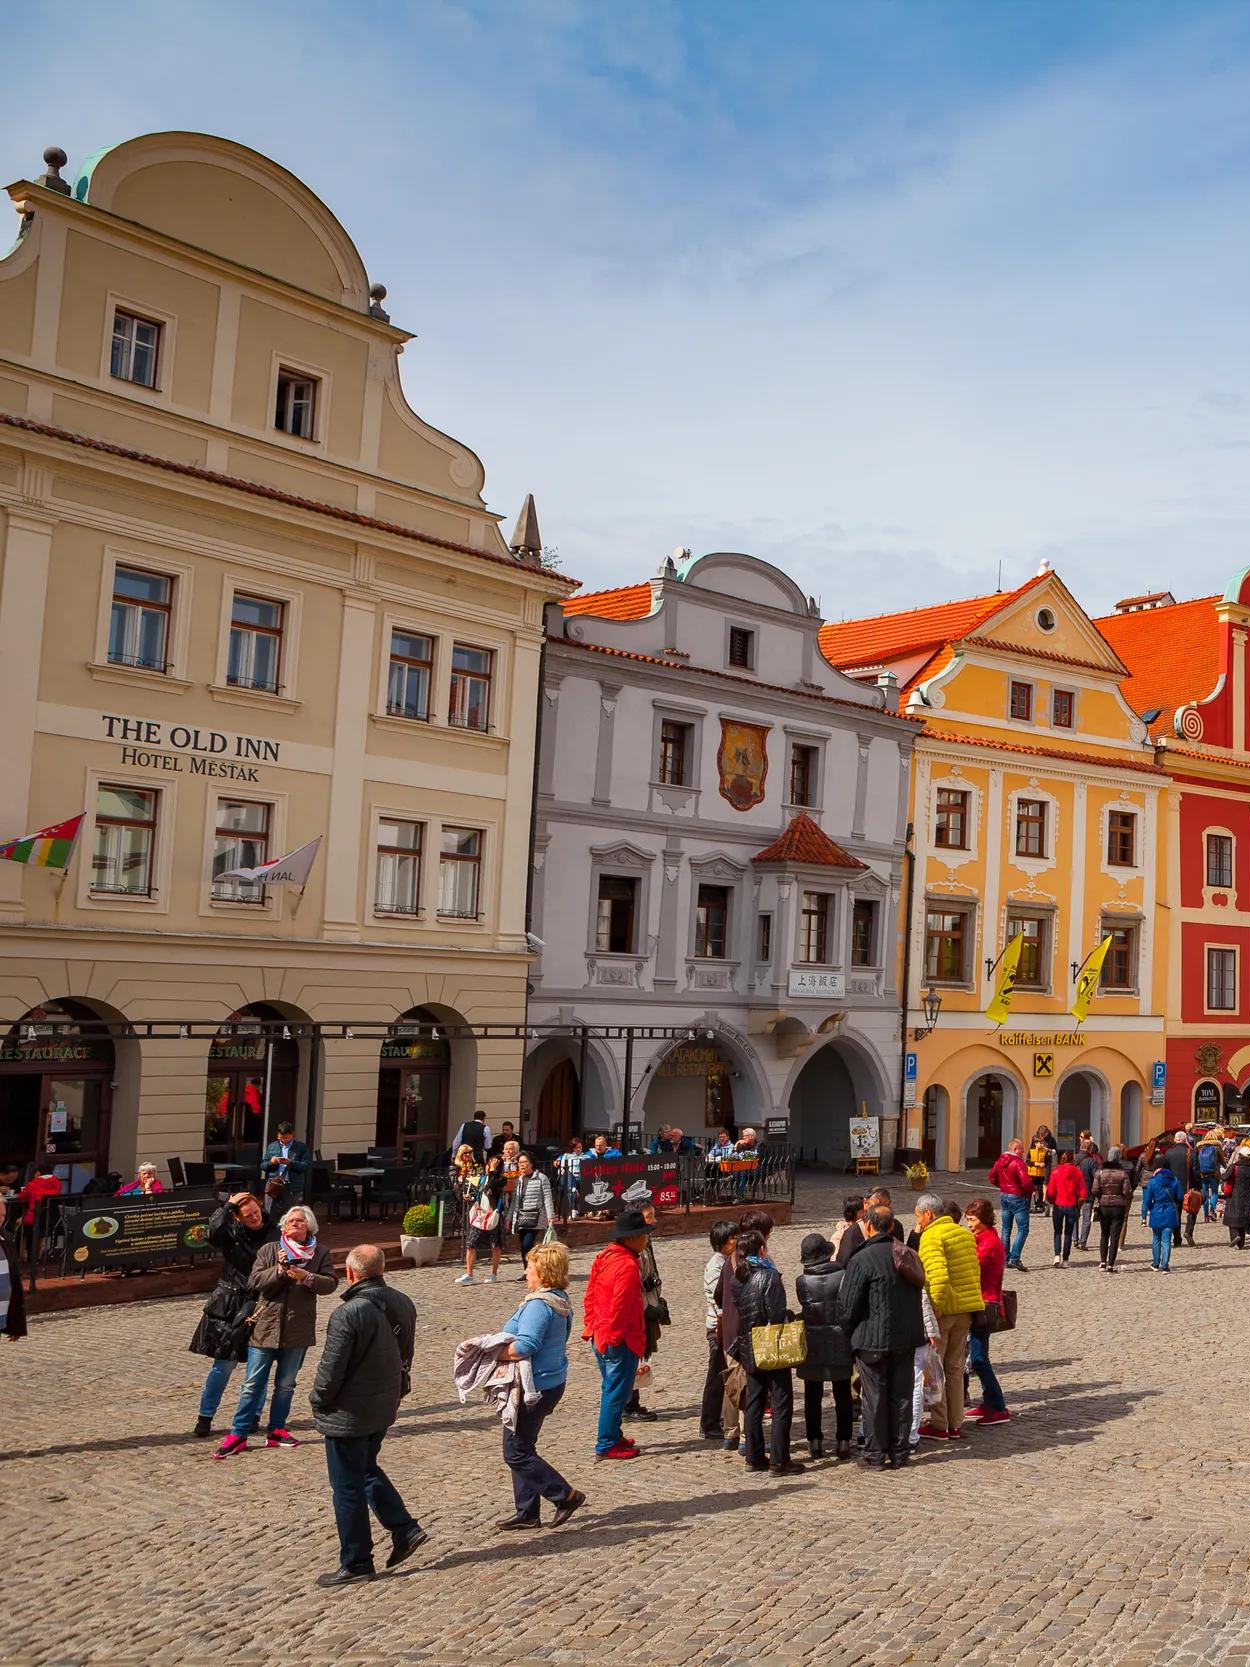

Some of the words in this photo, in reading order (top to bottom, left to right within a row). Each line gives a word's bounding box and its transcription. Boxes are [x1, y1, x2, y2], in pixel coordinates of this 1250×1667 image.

[102, 715, 161, 745] THE
[169, 727, 228, 754] OLD
[235, 736, 281, 763] INN
[121, 747, 183, 772] HOTEL
[1000, 1033, 1052, 1047] Raiffeisen
[1054, 1034, 1087, 1047] BANK
[907, 1056, 915, 1073] P
[1155, 1065, 1164, 1080] P
